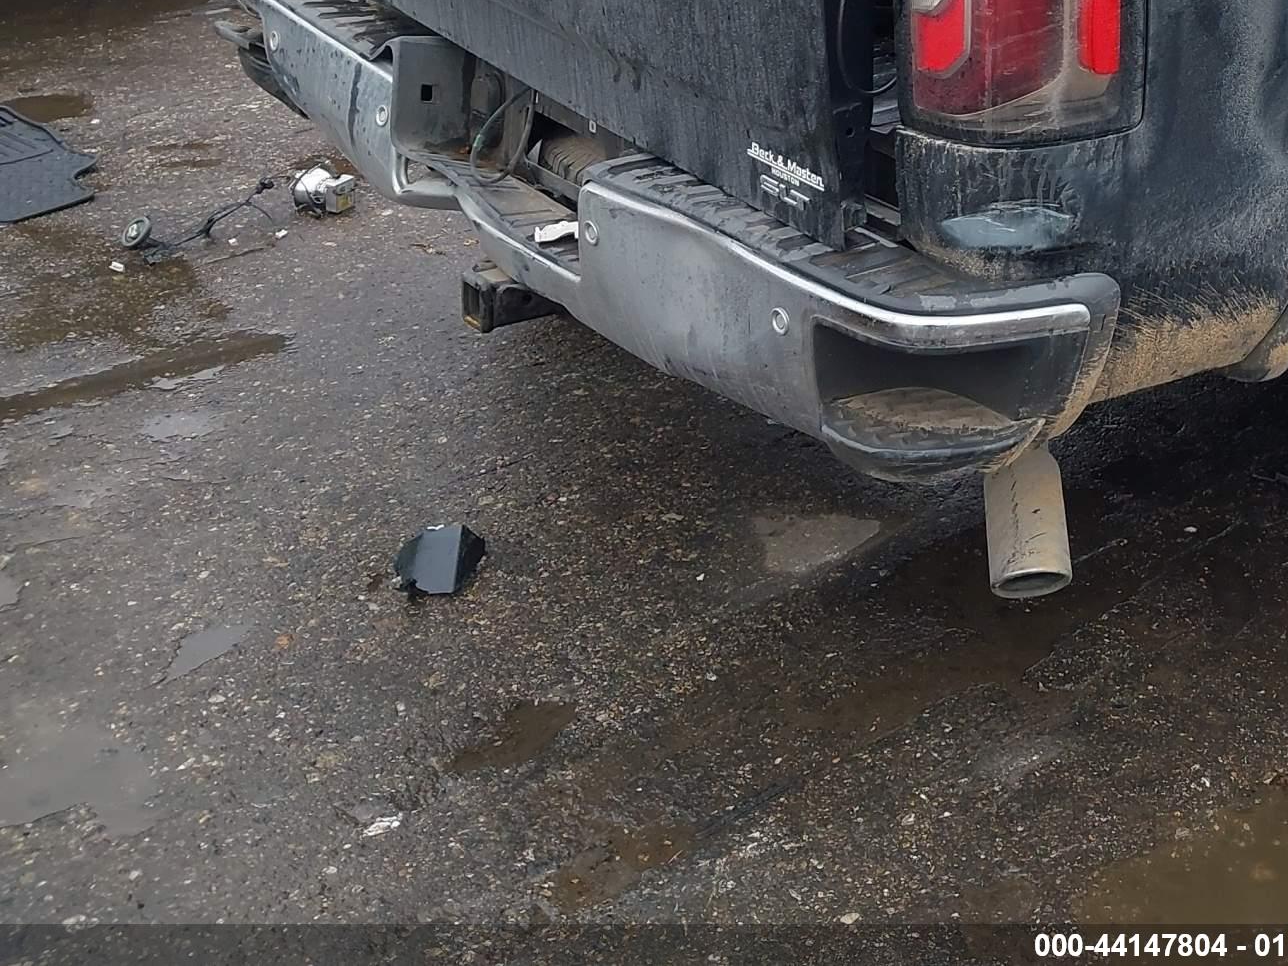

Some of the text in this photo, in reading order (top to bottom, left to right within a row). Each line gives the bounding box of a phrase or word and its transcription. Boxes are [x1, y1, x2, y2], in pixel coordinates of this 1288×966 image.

[751, 141, 825, 188] Beck & Masten
[771, 167, 800, 187] HOUSTON
[760, 174, 811, 211] SLT
